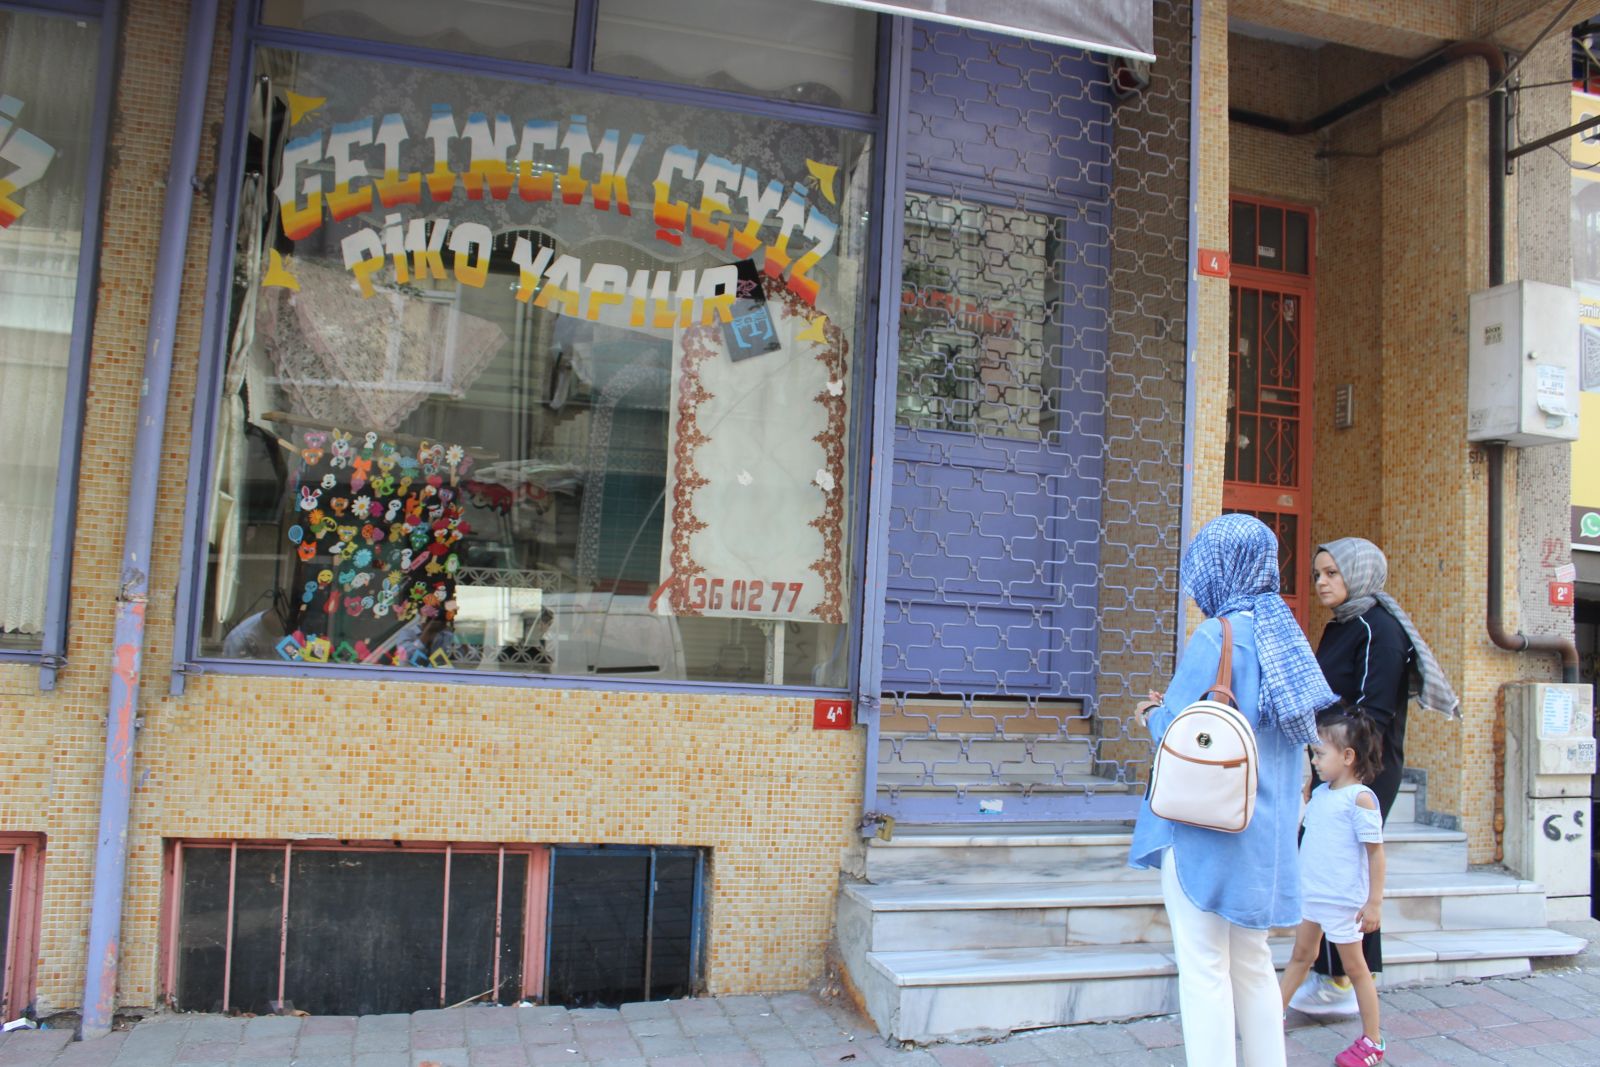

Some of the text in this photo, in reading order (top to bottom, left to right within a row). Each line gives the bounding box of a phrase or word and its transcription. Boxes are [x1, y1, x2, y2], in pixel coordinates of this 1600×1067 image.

[275, 103, 839, 306] GELİNCİK ÇEYİZ
[340, 213, 739, 329] PİKO YAPILIR
[1210, 256, 1219, 271] 4
[730, 579, 764, 612] 02
[771, 582, 804, 613] 77
[826, 706, 843, 723] 4A
